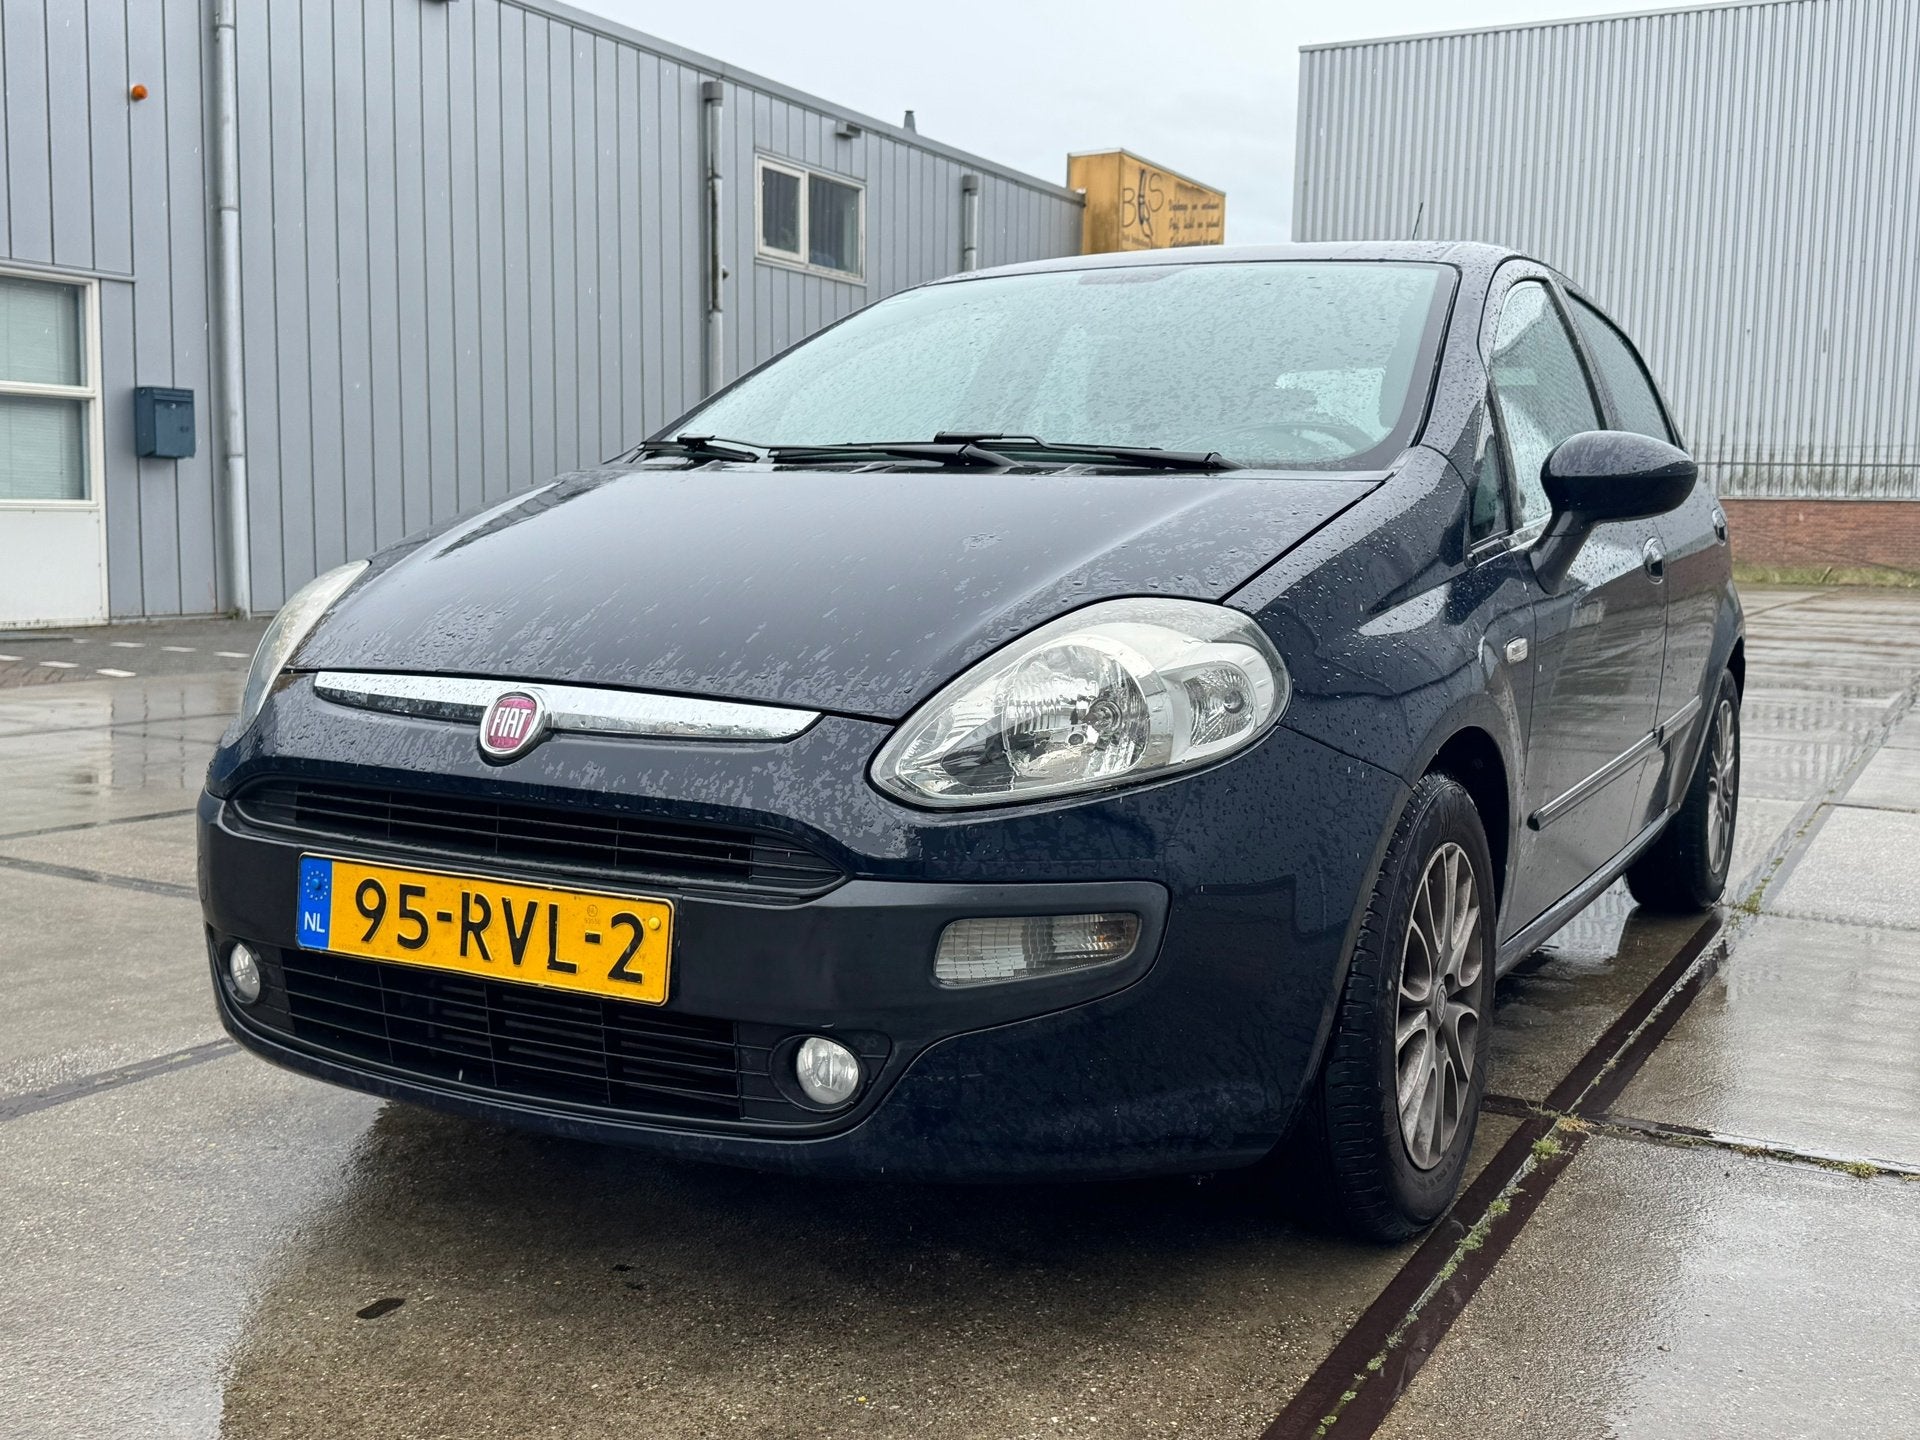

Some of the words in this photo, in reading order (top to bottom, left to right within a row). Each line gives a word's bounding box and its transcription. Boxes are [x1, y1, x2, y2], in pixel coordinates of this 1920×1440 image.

[490, 706, 532, 739] FIAT
[304, 911, 325, 934] NL
[354, 877, 645, 985] 95-RVL-2
